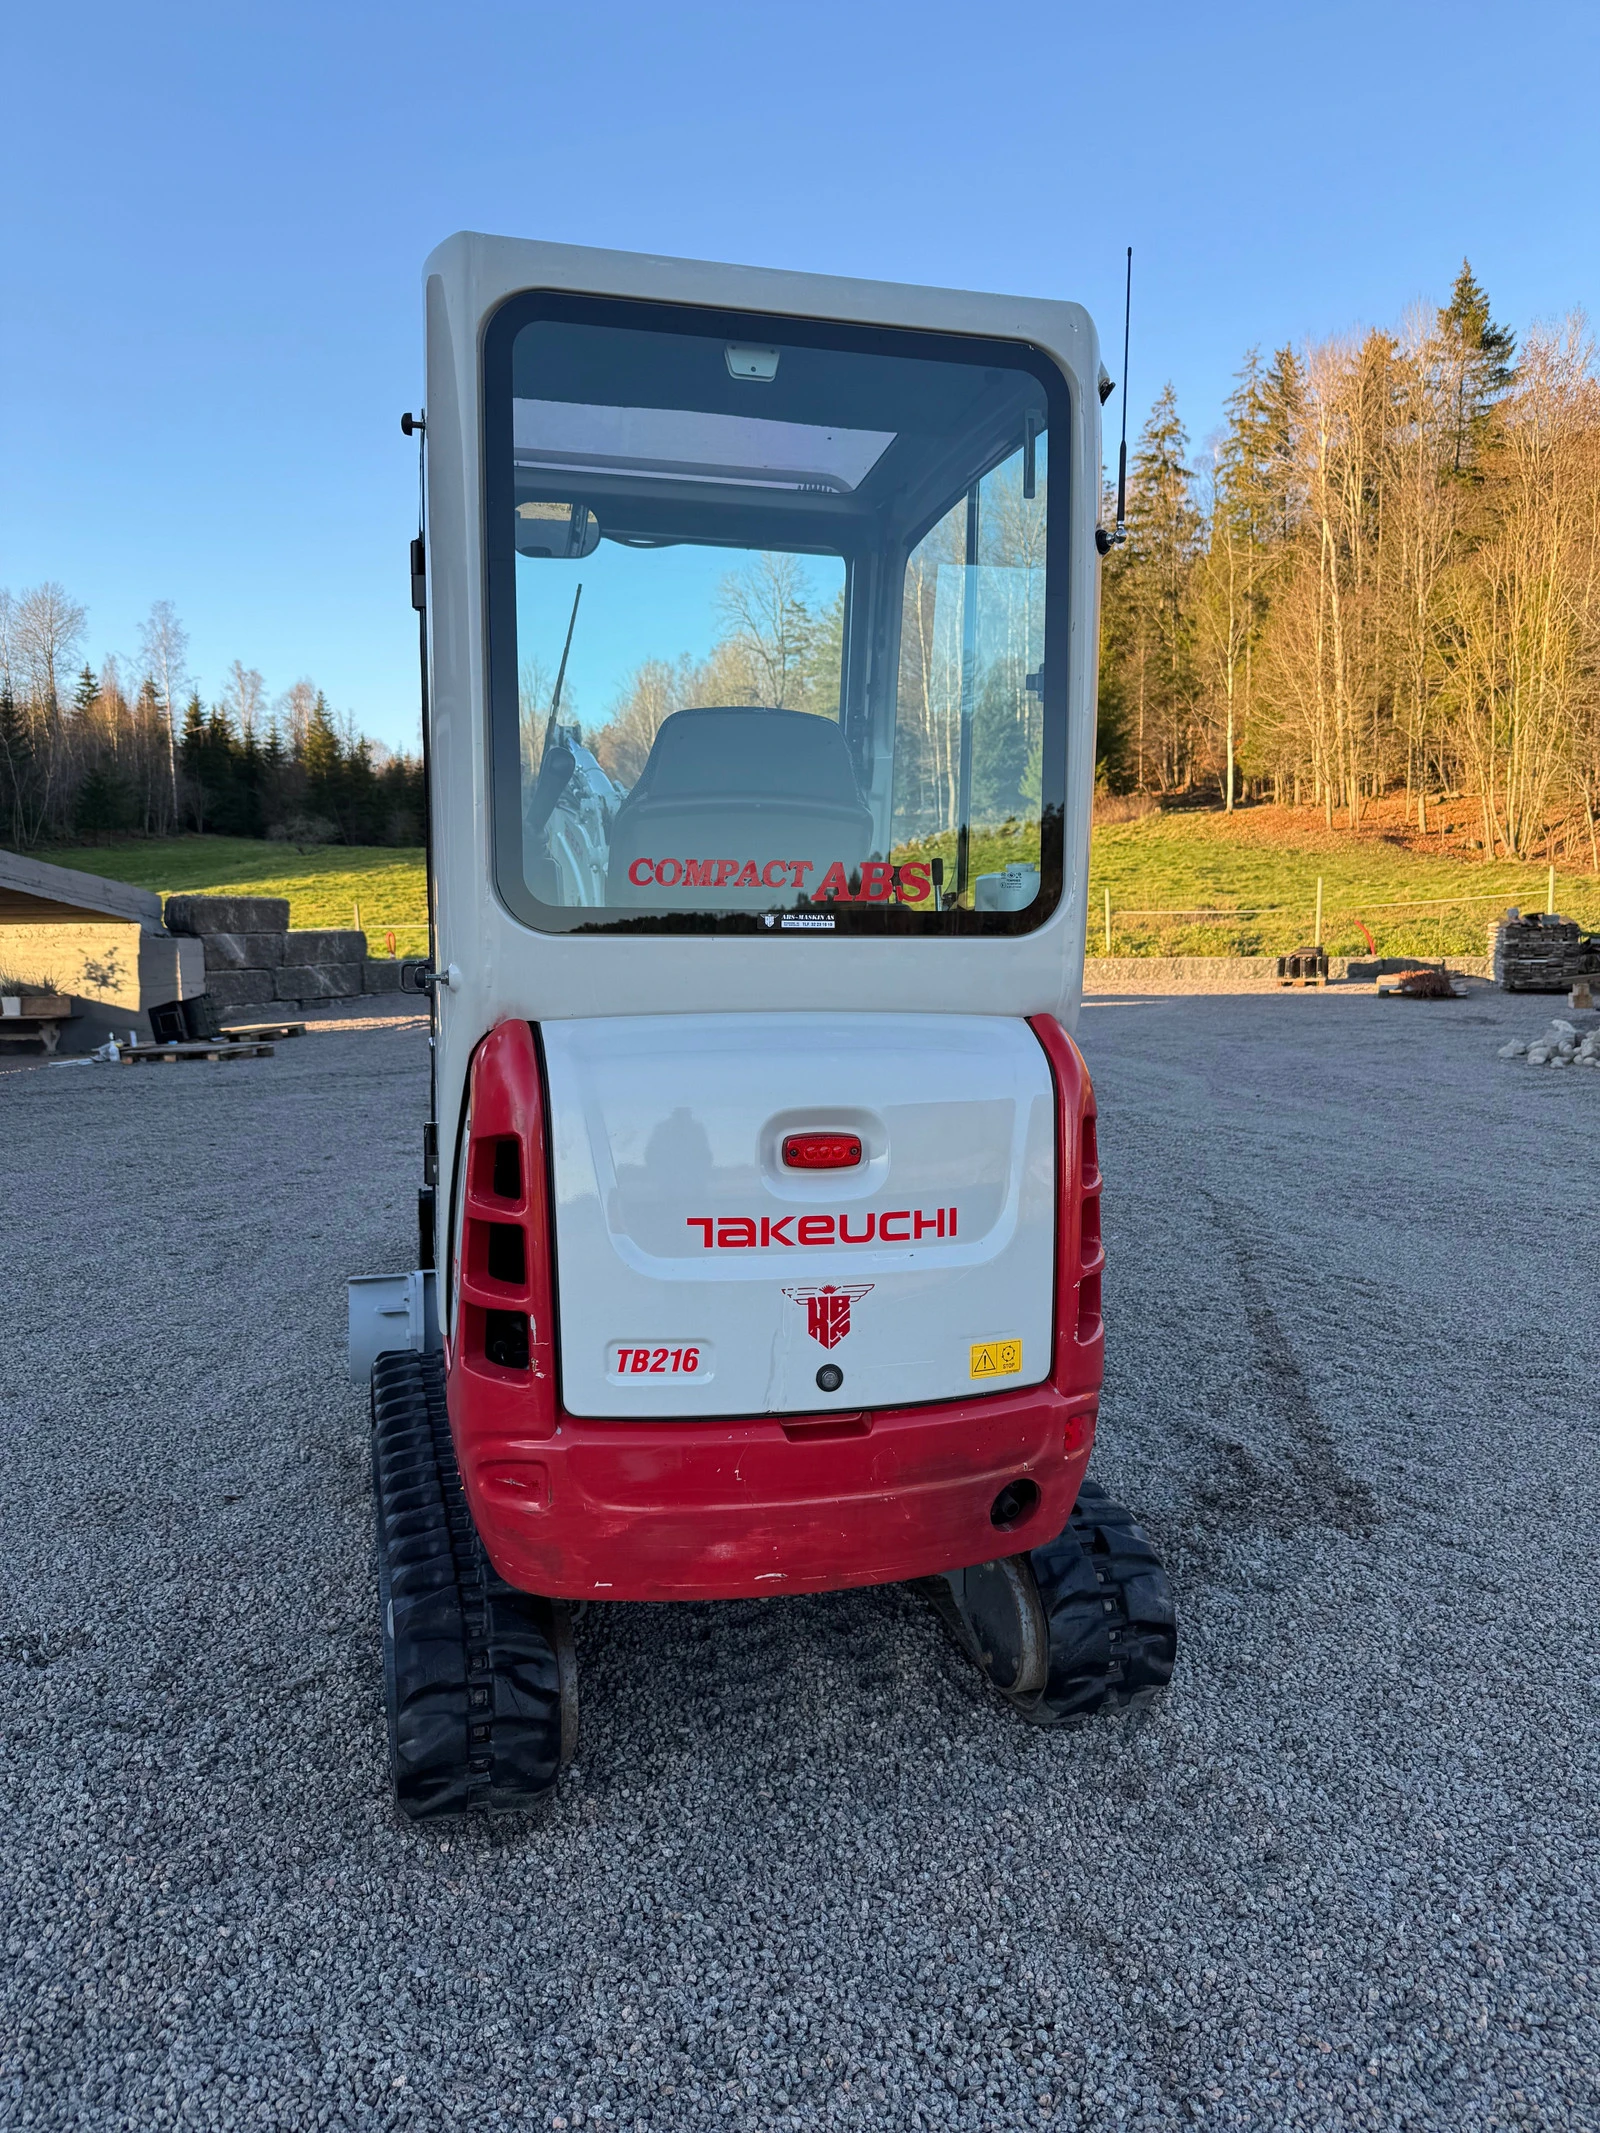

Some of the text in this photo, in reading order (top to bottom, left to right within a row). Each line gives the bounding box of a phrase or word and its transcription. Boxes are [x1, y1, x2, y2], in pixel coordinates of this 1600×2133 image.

[628, 857, 932, 902] COMPACT ABS
[686, 1207, 958, 1248] TAKEUCHI
[617, 1347, 700, 1373] TB216
